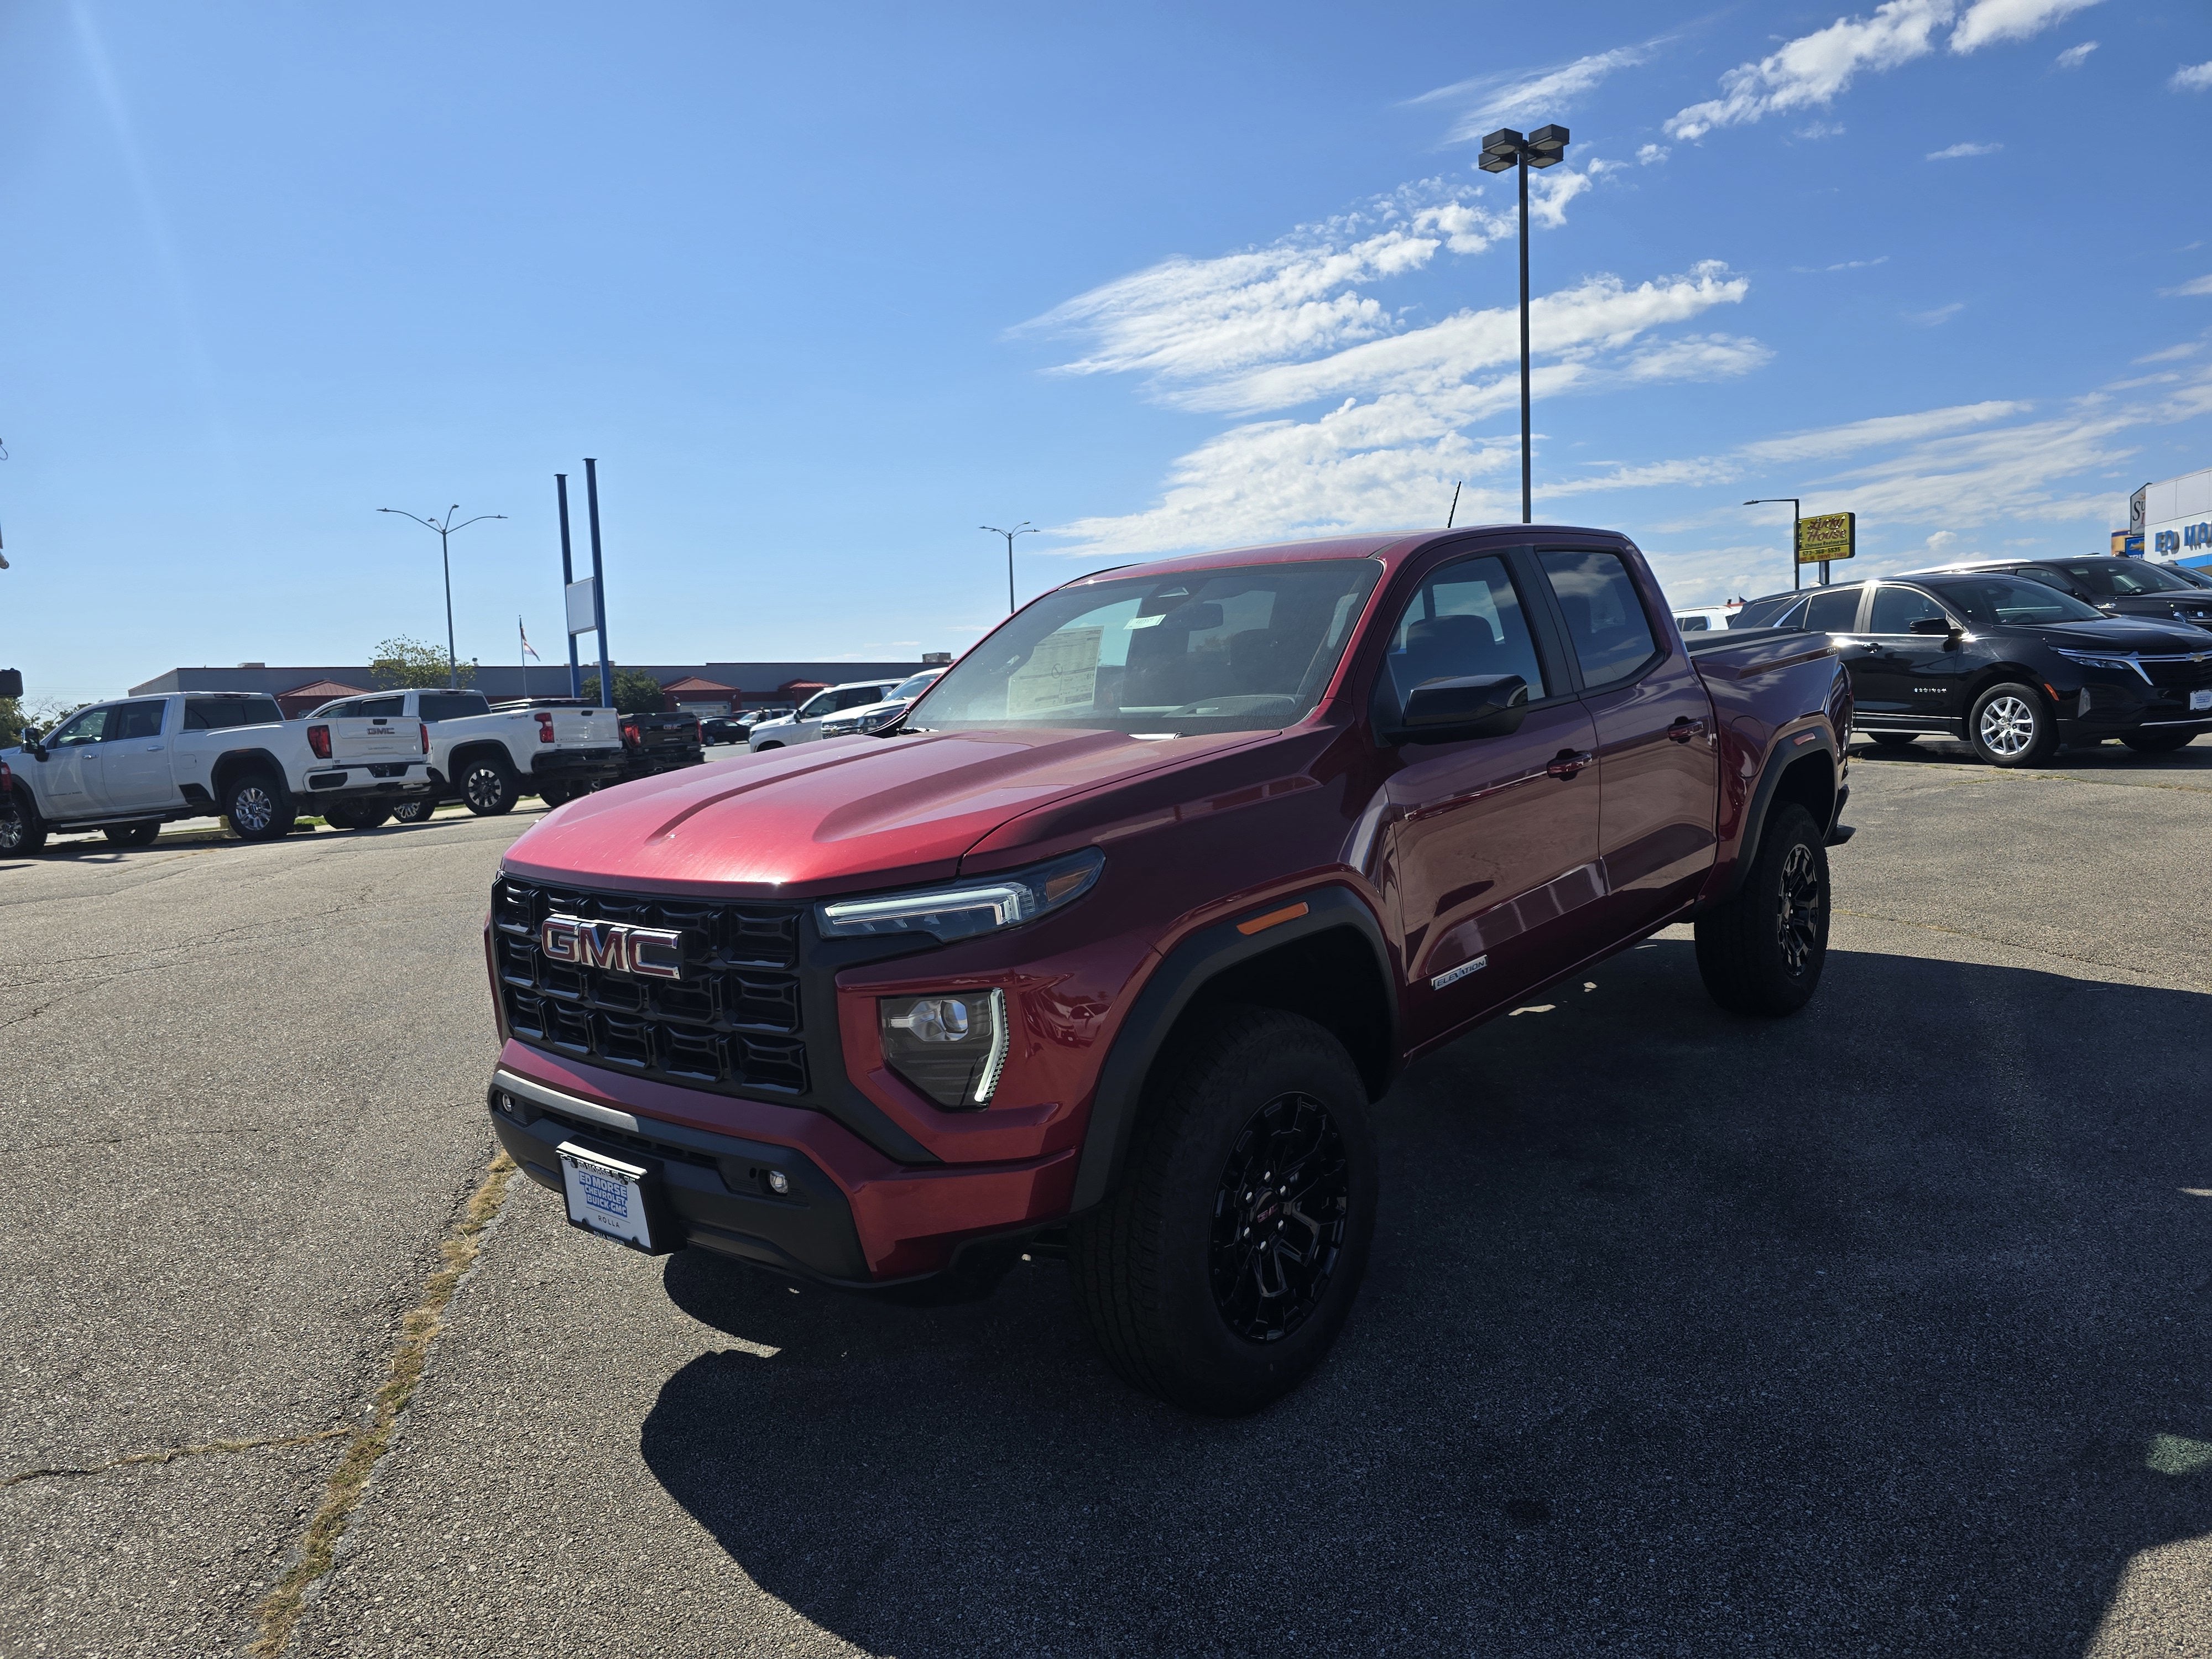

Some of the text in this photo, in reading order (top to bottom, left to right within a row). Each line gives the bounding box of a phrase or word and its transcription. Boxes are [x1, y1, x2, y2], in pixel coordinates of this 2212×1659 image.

[1807, 529, 1847, 542] House
[2155, 520, 2212, 552] ED MO
[541, 914, 682, 980] GMC
[1437, 960, 1485, 987] ELEVATION
[580, 1173, 592, 1185] ED
[592, 1175, 627, 1198] MORSE
[598, 1215, 620, 1228] ROLLA
